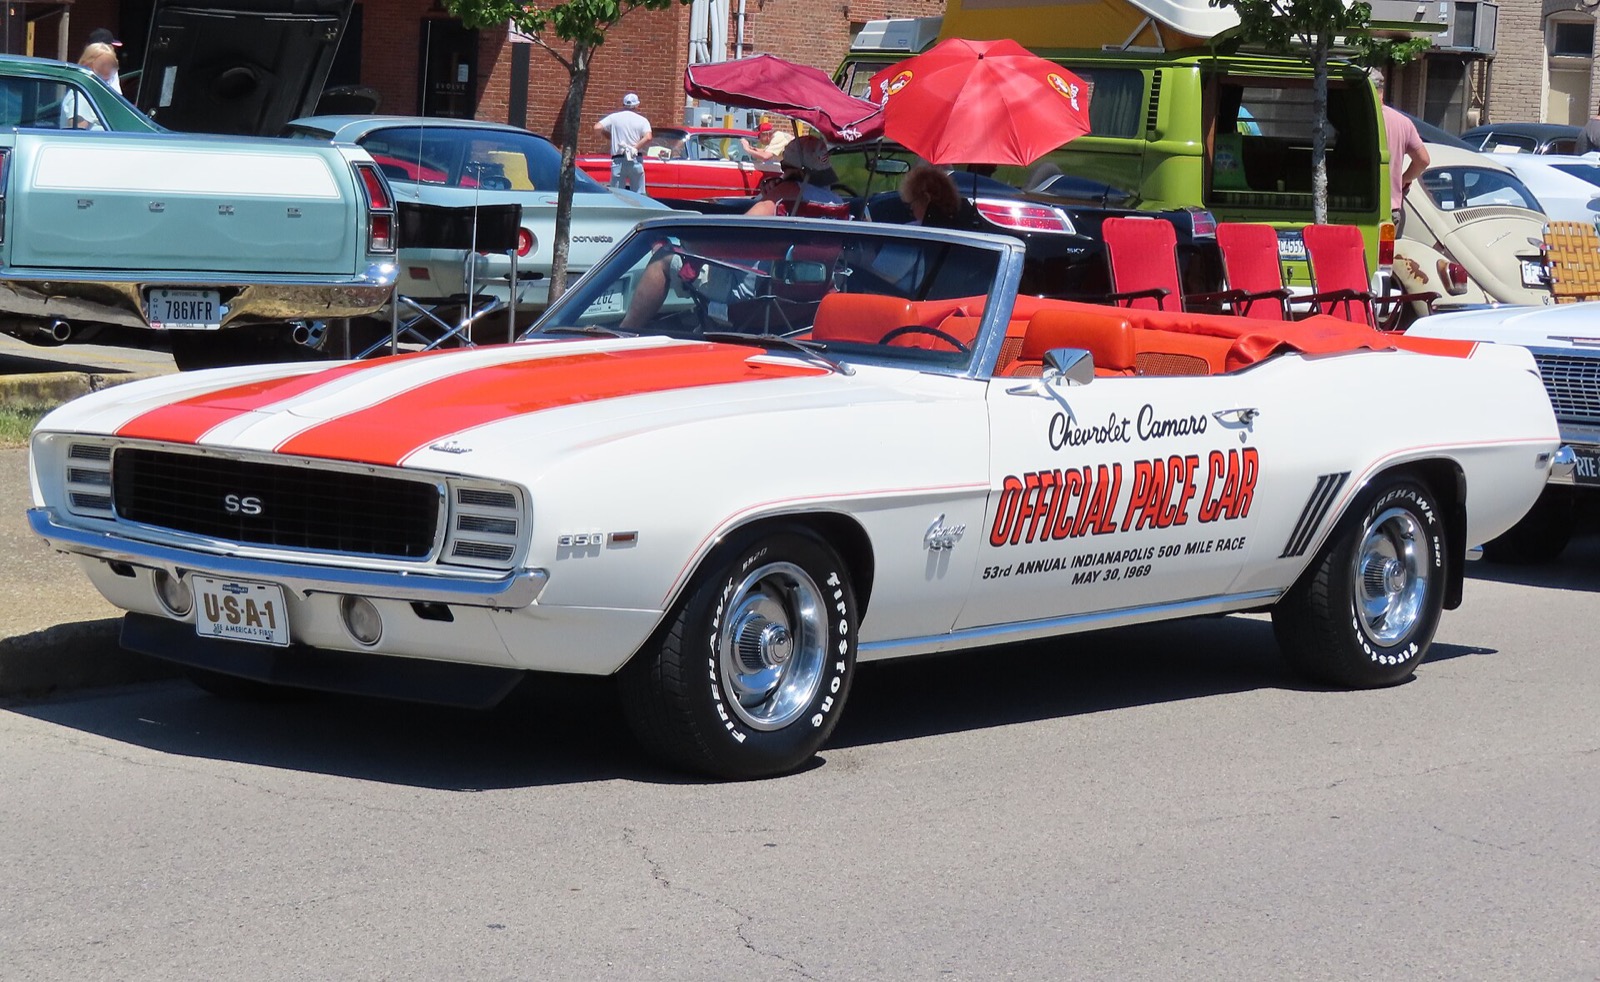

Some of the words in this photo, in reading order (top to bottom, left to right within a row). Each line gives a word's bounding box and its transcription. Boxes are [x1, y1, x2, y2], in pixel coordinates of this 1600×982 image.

[572, 235, 614, 243] corvette
[165, 300, 213, 320] 786XFR
[1049, 411, 1131, 451] Chevrolet
[1137, 404, 1207, 441] Camaro
[225, 494, 262, 515] SS
[990, 462, 1123, 547] OFFICIAL
[1120, 455, 1200, 533] PACE
[1197, 447, 1259, 523] CAR
[558, 533, 604, 547] 350
[982, 565, 1013, 580] 53rd
[1015, 557, 1067, 576] ANNUAL
[1070, 547, 1155, 569] INDIANAPOLIS
[1157, 544, 1181, 558] 500
[1184, 540, 1214, 555] MILE
[1215, 537, 1247, 552] RACE
[1071, 570, 1102, 585] MAY
[1102, 568, 1121, 581] 30,
[1123, 564, 1152, 579] 1969
[213, 623, 223, 631] SEE
[259, 629, 274, 638] FIRST
[708, 576, 746, 743] FIREHAWK
[811, 572, 848, 728] Firestone
